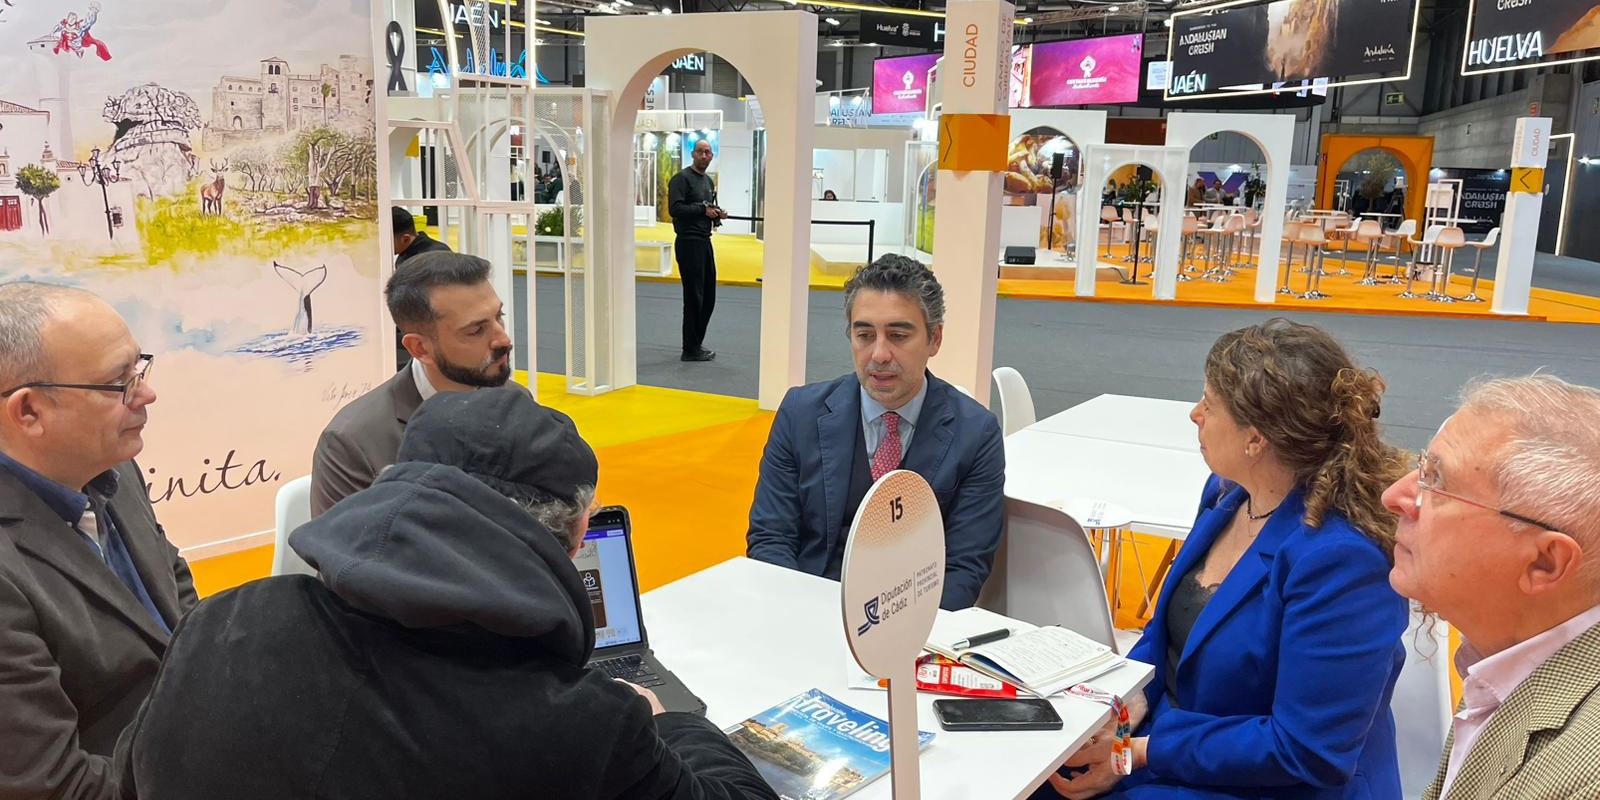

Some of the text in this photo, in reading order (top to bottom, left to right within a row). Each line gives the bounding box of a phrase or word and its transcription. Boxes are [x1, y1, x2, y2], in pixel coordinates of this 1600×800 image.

[1179, 28, 1227, 46] ANDALUSIAN
[1467, 30, 1543, 66] HUELVA
[963, 24, 979, 88] CIUDAD
[1168, 69, 1207, 95] JAÉN
[889, 496, 904, 524] 15
[881, 578, 913, 605] Diputación
[882, 597, 908, 621] de Cádiz
